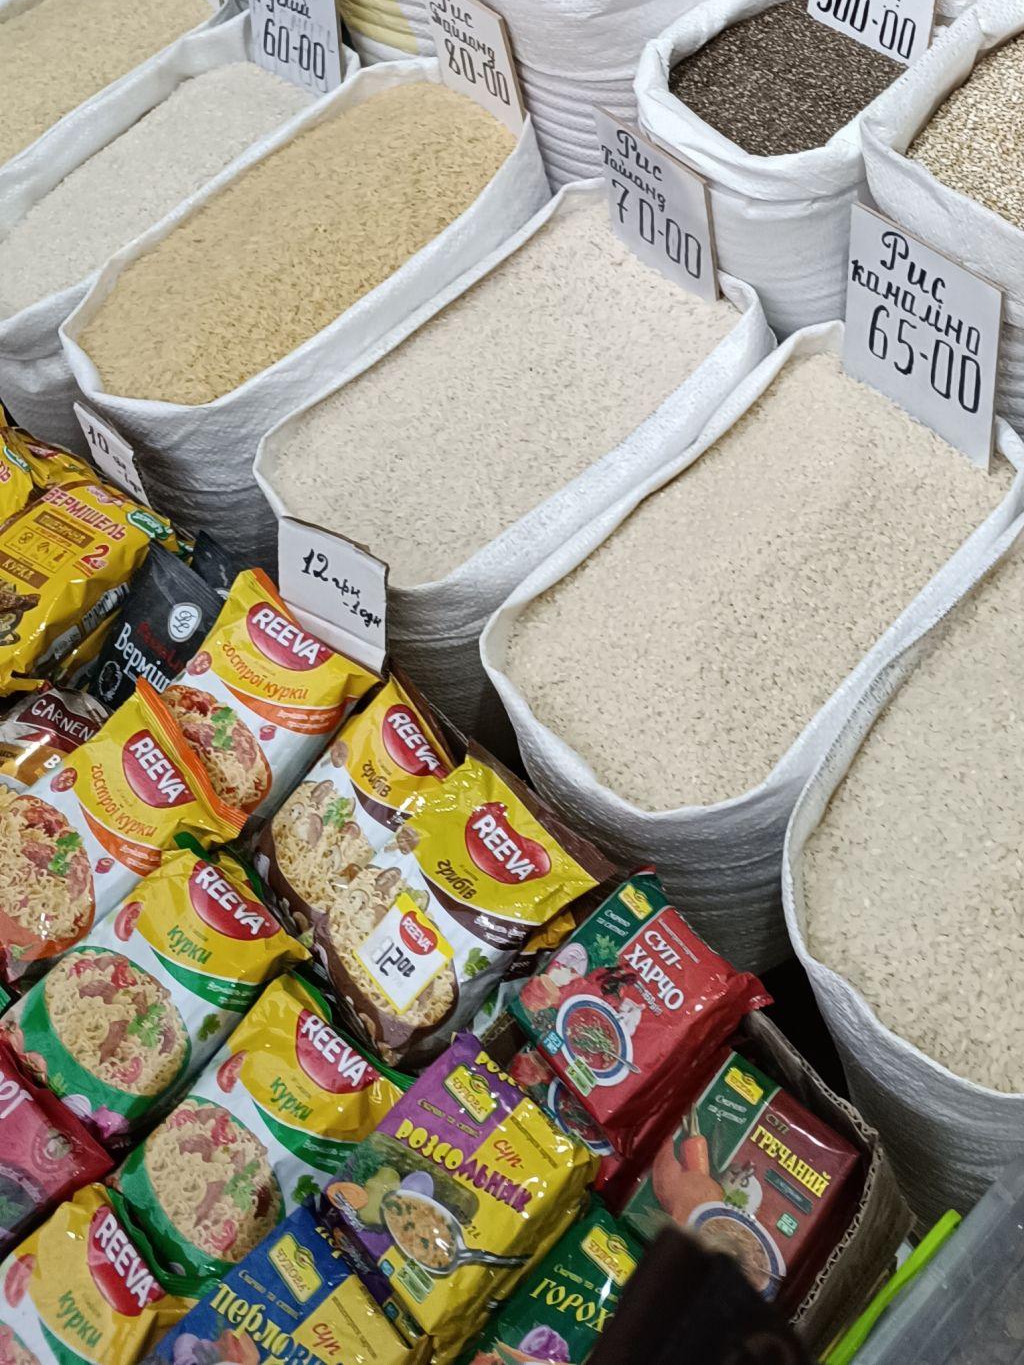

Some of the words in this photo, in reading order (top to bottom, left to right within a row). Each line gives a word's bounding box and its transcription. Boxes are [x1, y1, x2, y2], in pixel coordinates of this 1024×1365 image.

[263, 18, 325, 80] 60-00
[444, 38, 510, 106] 80-00
[616, 129, 663, 182] Рис
[611, 179, 702, 280] 70-00
[880, 231, 946, 305] Рис
[868, 304, 981, 414] 65-00
[42, 486, 128, 542] ВЕРМІШЕЛЬ
[301, 548, 329, 582] 12
[251, 608, 320, 665] REEVA
[129, 736, 186, 804] REEVA
[386, 712, 441, 771] REEVA
[434, 858, 477, 901] грибів
[471, 812, 536, 883] REEVA
[195, 866, 267, 935] REEVA
[402, 916, 432, 953] REEVA
[623, 942, 685, 1010] ХАРЧО
[301, 1015, 369, 1087] REEVA
[750, 1124, 832, 1198] ГРЕЧАНИЙ
[95, 1210, 155, 1308] REEVA
